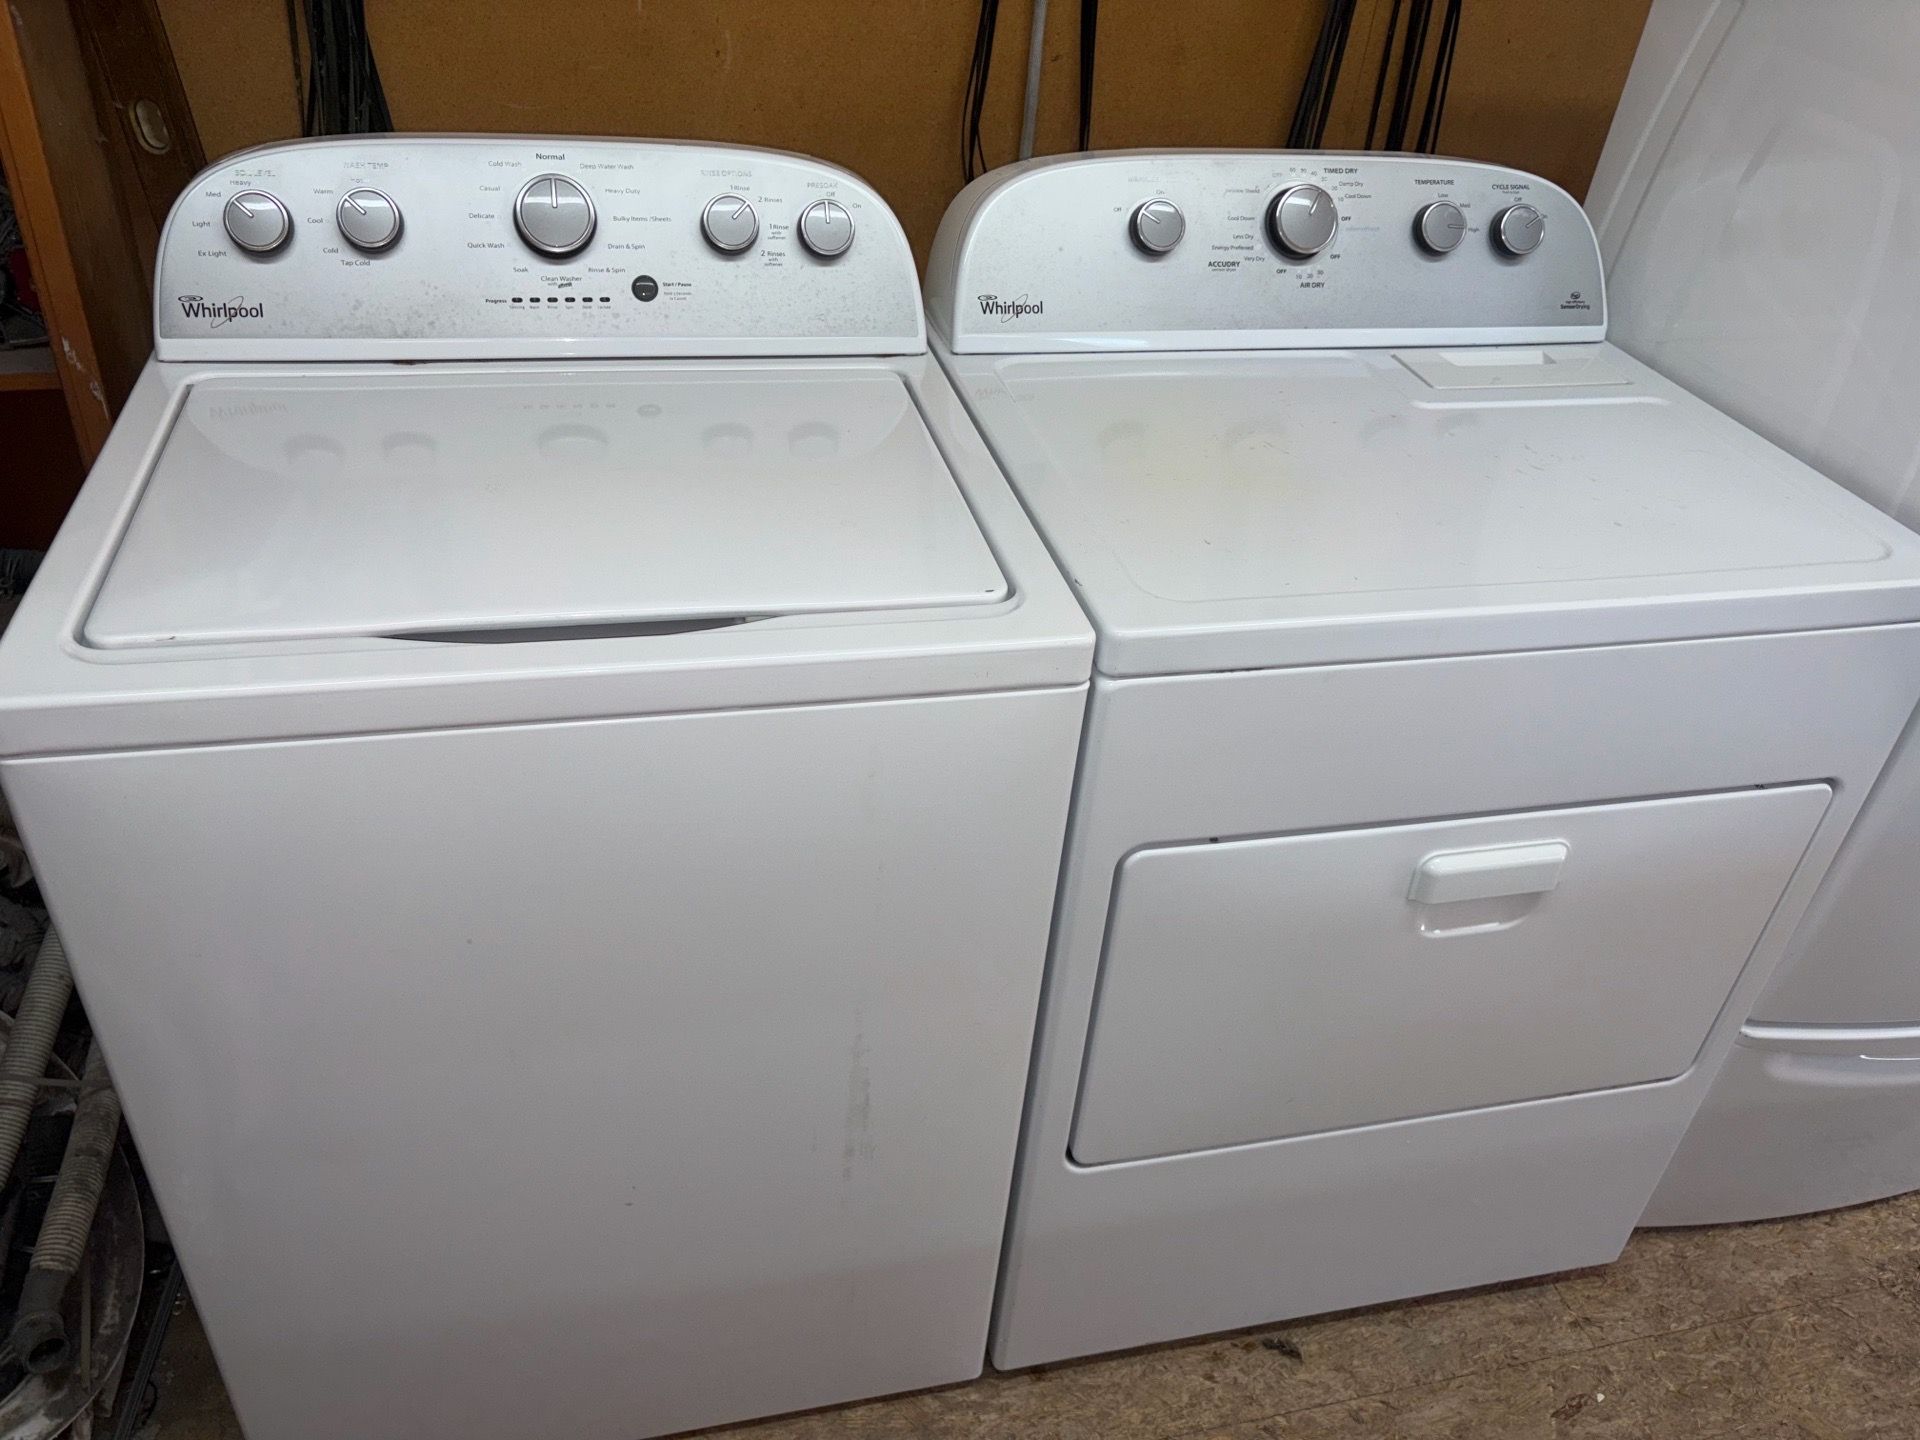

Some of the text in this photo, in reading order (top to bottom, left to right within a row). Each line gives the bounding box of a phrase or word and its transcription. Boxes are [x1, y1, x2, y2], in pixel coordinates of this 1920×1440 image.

[230, 179, 252, 187] Heavy
[181, 302, 264, 322] Whirlpool
[980, 300, 1043, 318] Whirlpool
